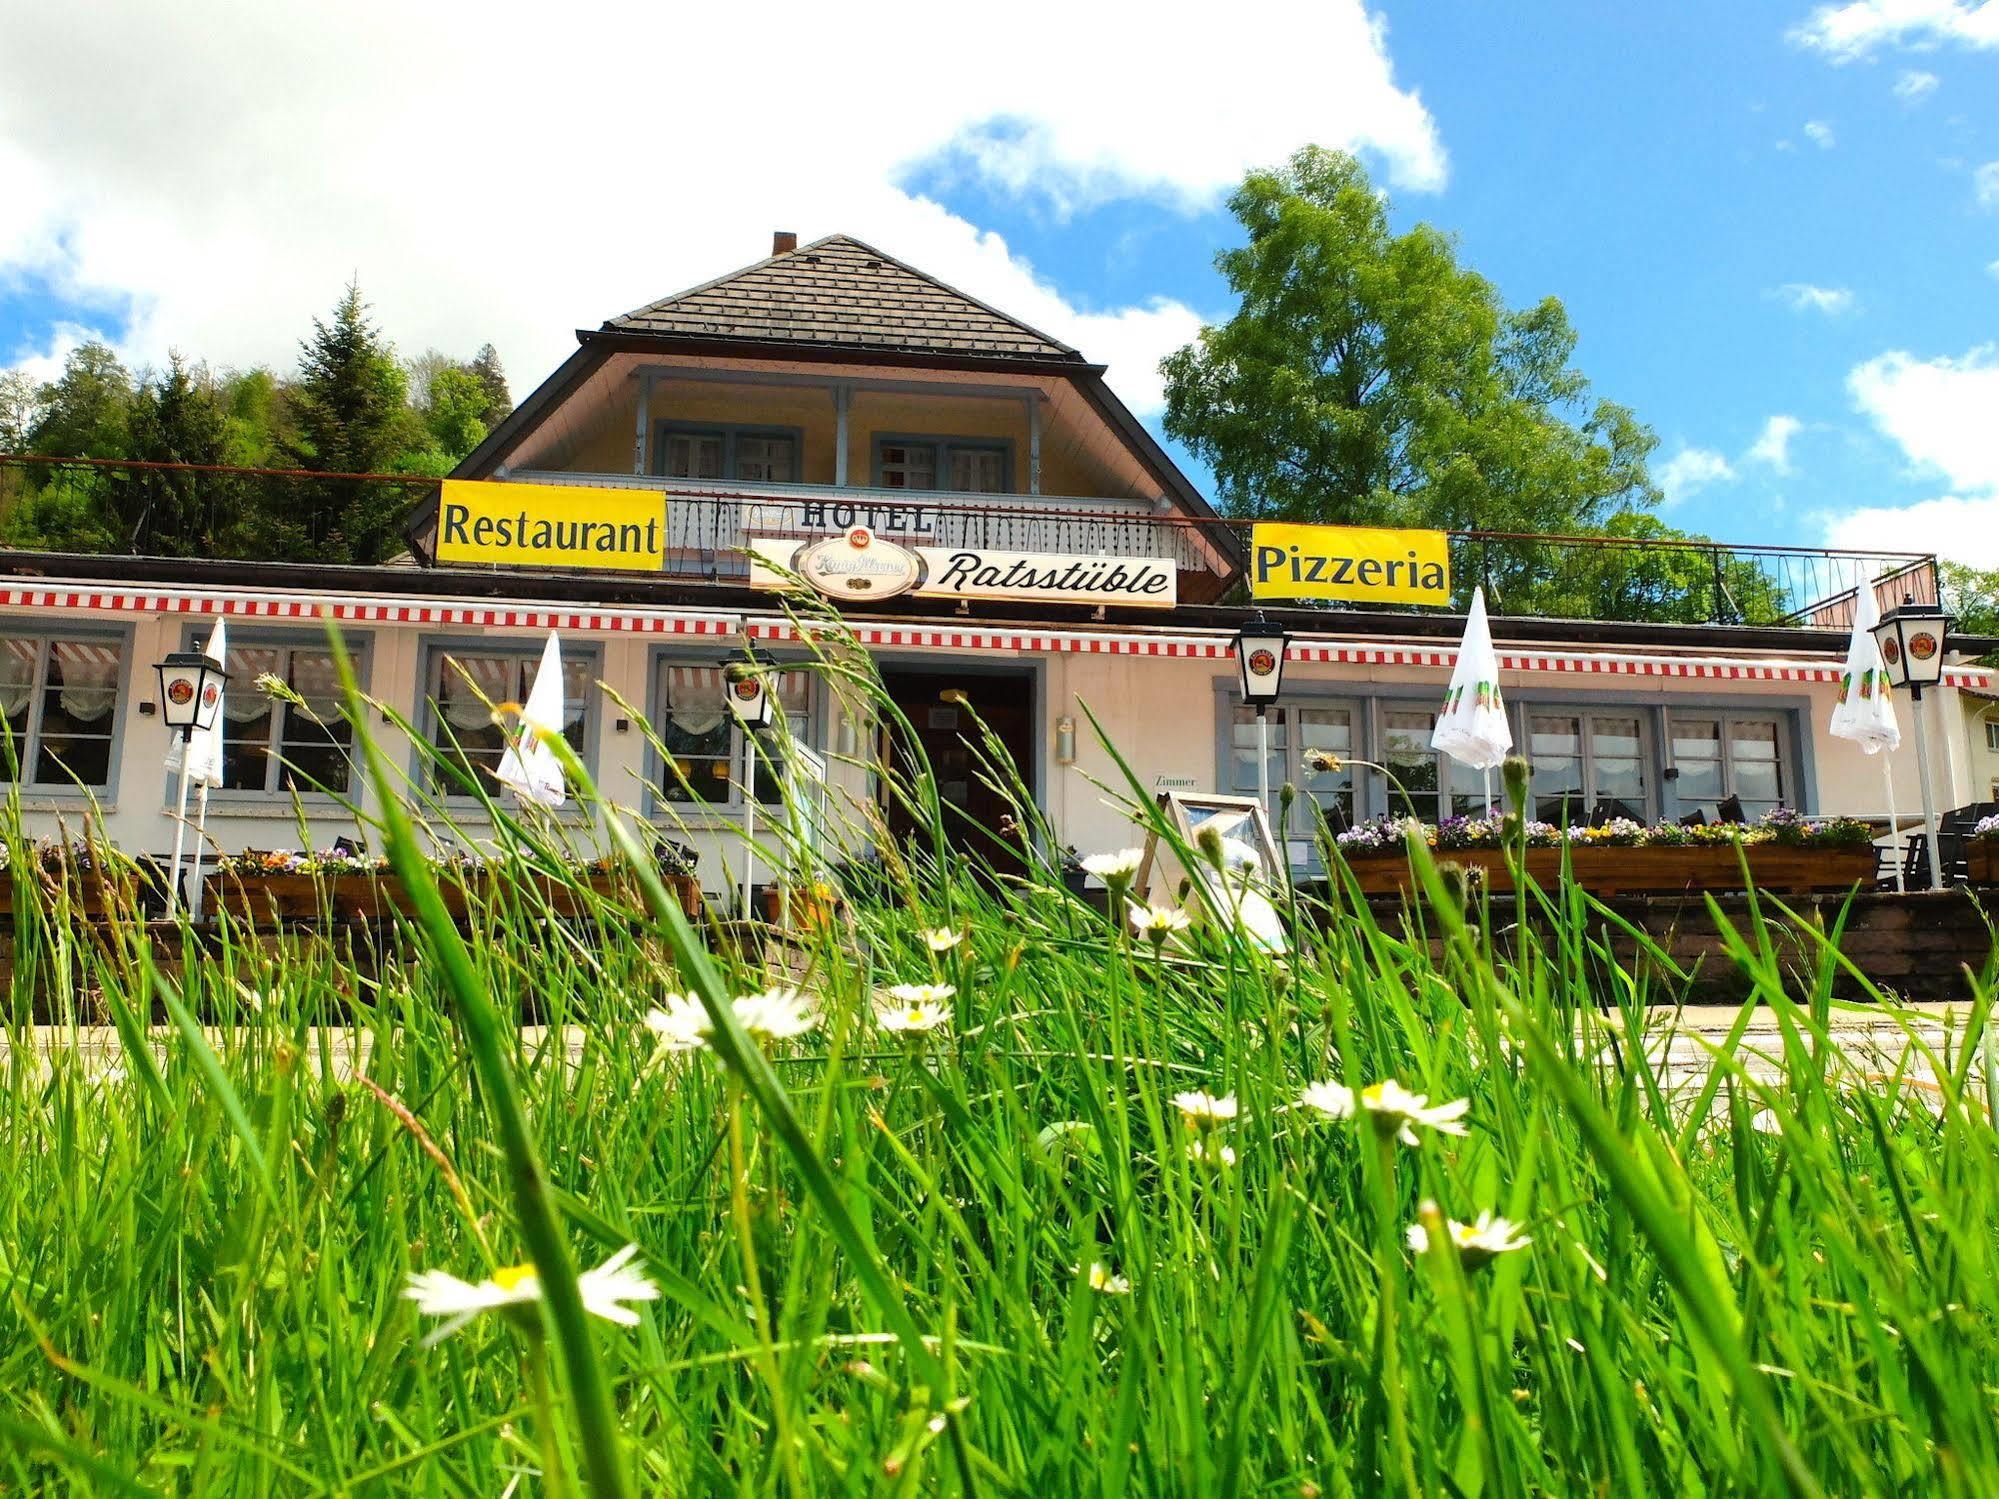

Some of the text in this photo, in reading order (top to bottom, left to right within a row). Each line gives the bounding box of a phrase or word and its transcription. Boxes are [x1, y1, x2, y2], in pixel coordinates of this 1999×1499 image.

[443, 504, 660, 554] Restaurant
[801, 501, 932, 533] HOTEL
[938, 552, 1169, 594] Ratsstüble
[1257, 545, 1445, 590] Pizzeria
[1155, 775, 1196, 786] Zimmer
